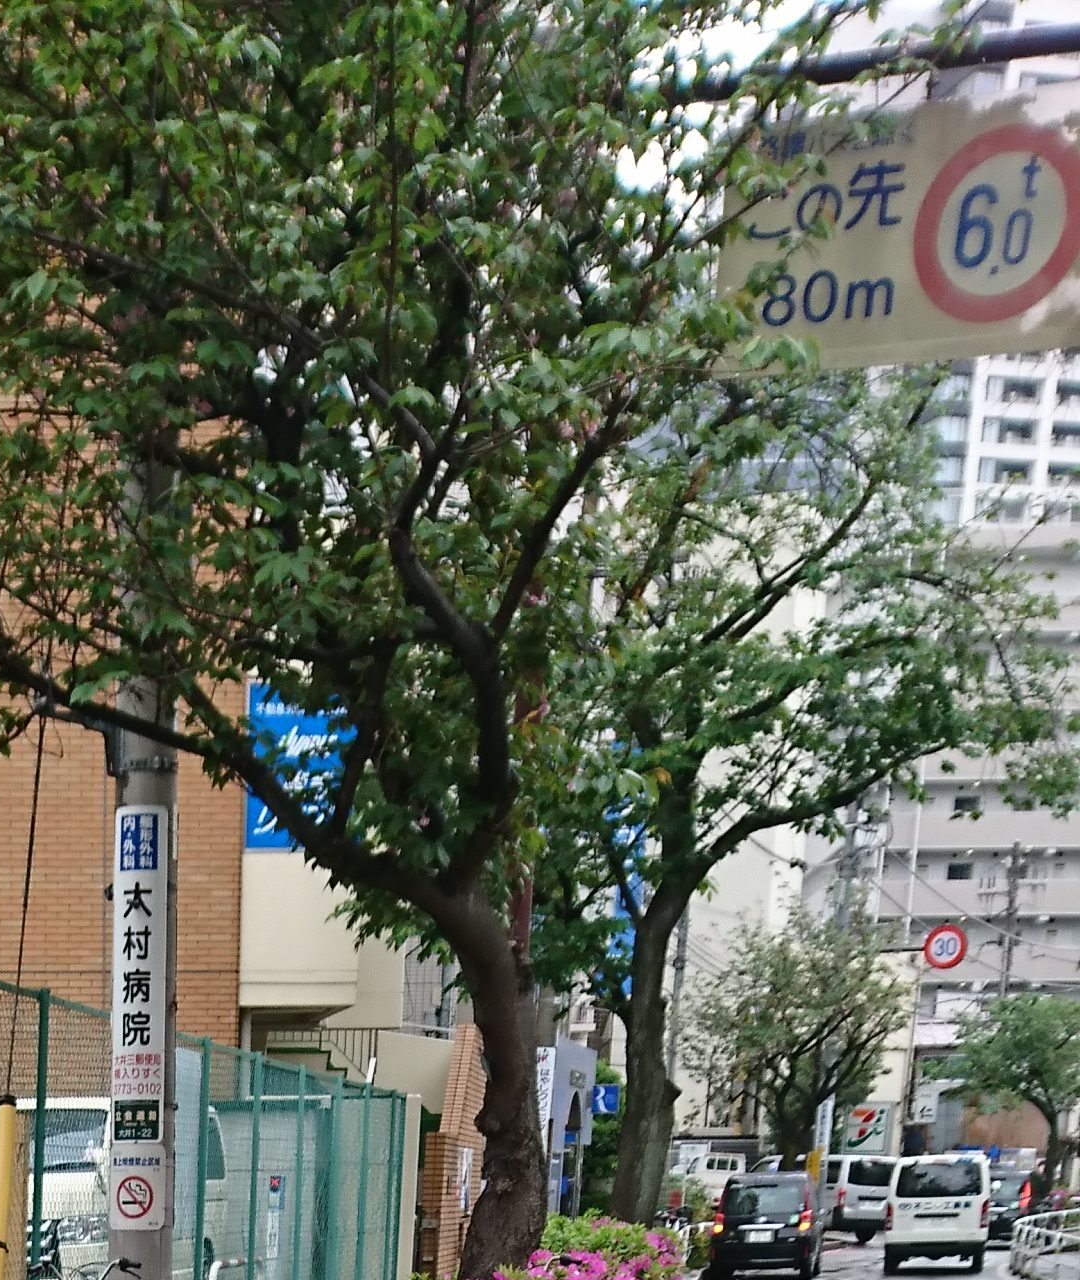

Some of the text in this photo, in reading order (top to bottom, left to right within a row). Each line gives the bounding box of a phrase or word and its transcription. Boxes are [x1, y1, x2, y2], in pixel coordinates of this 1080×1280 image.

[761, 270, 896, 327] 80m
[122, 881, 153, 1047] 大村病院
[934, 937, 958, 957] 30
